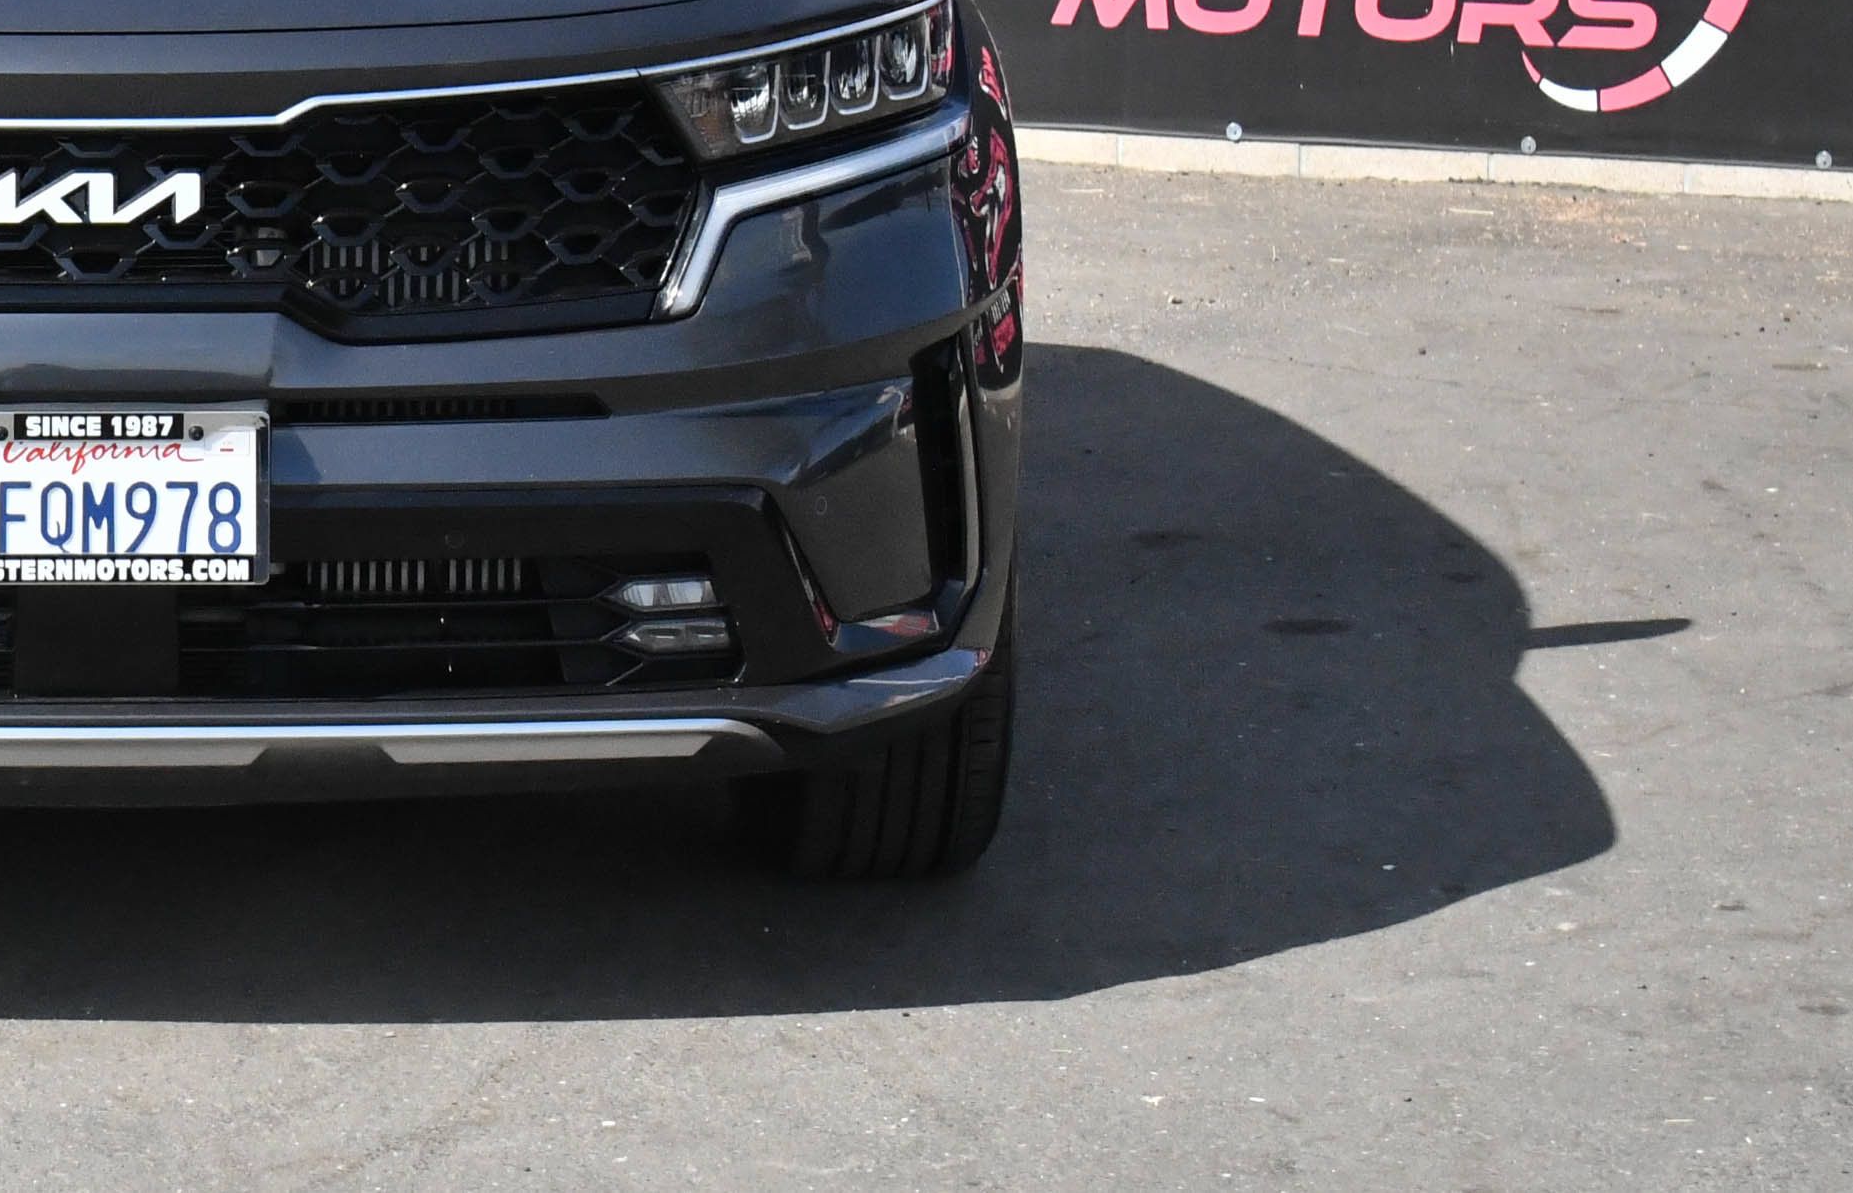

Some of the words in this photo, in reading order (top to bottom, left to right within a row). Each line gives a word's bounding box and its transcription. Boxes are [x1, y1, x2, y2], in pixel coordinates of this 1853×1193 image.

[25, 415, 102, 438] SINCE
[110, 415, 174, 438] 1987
[3, 440, 204, 475] California
